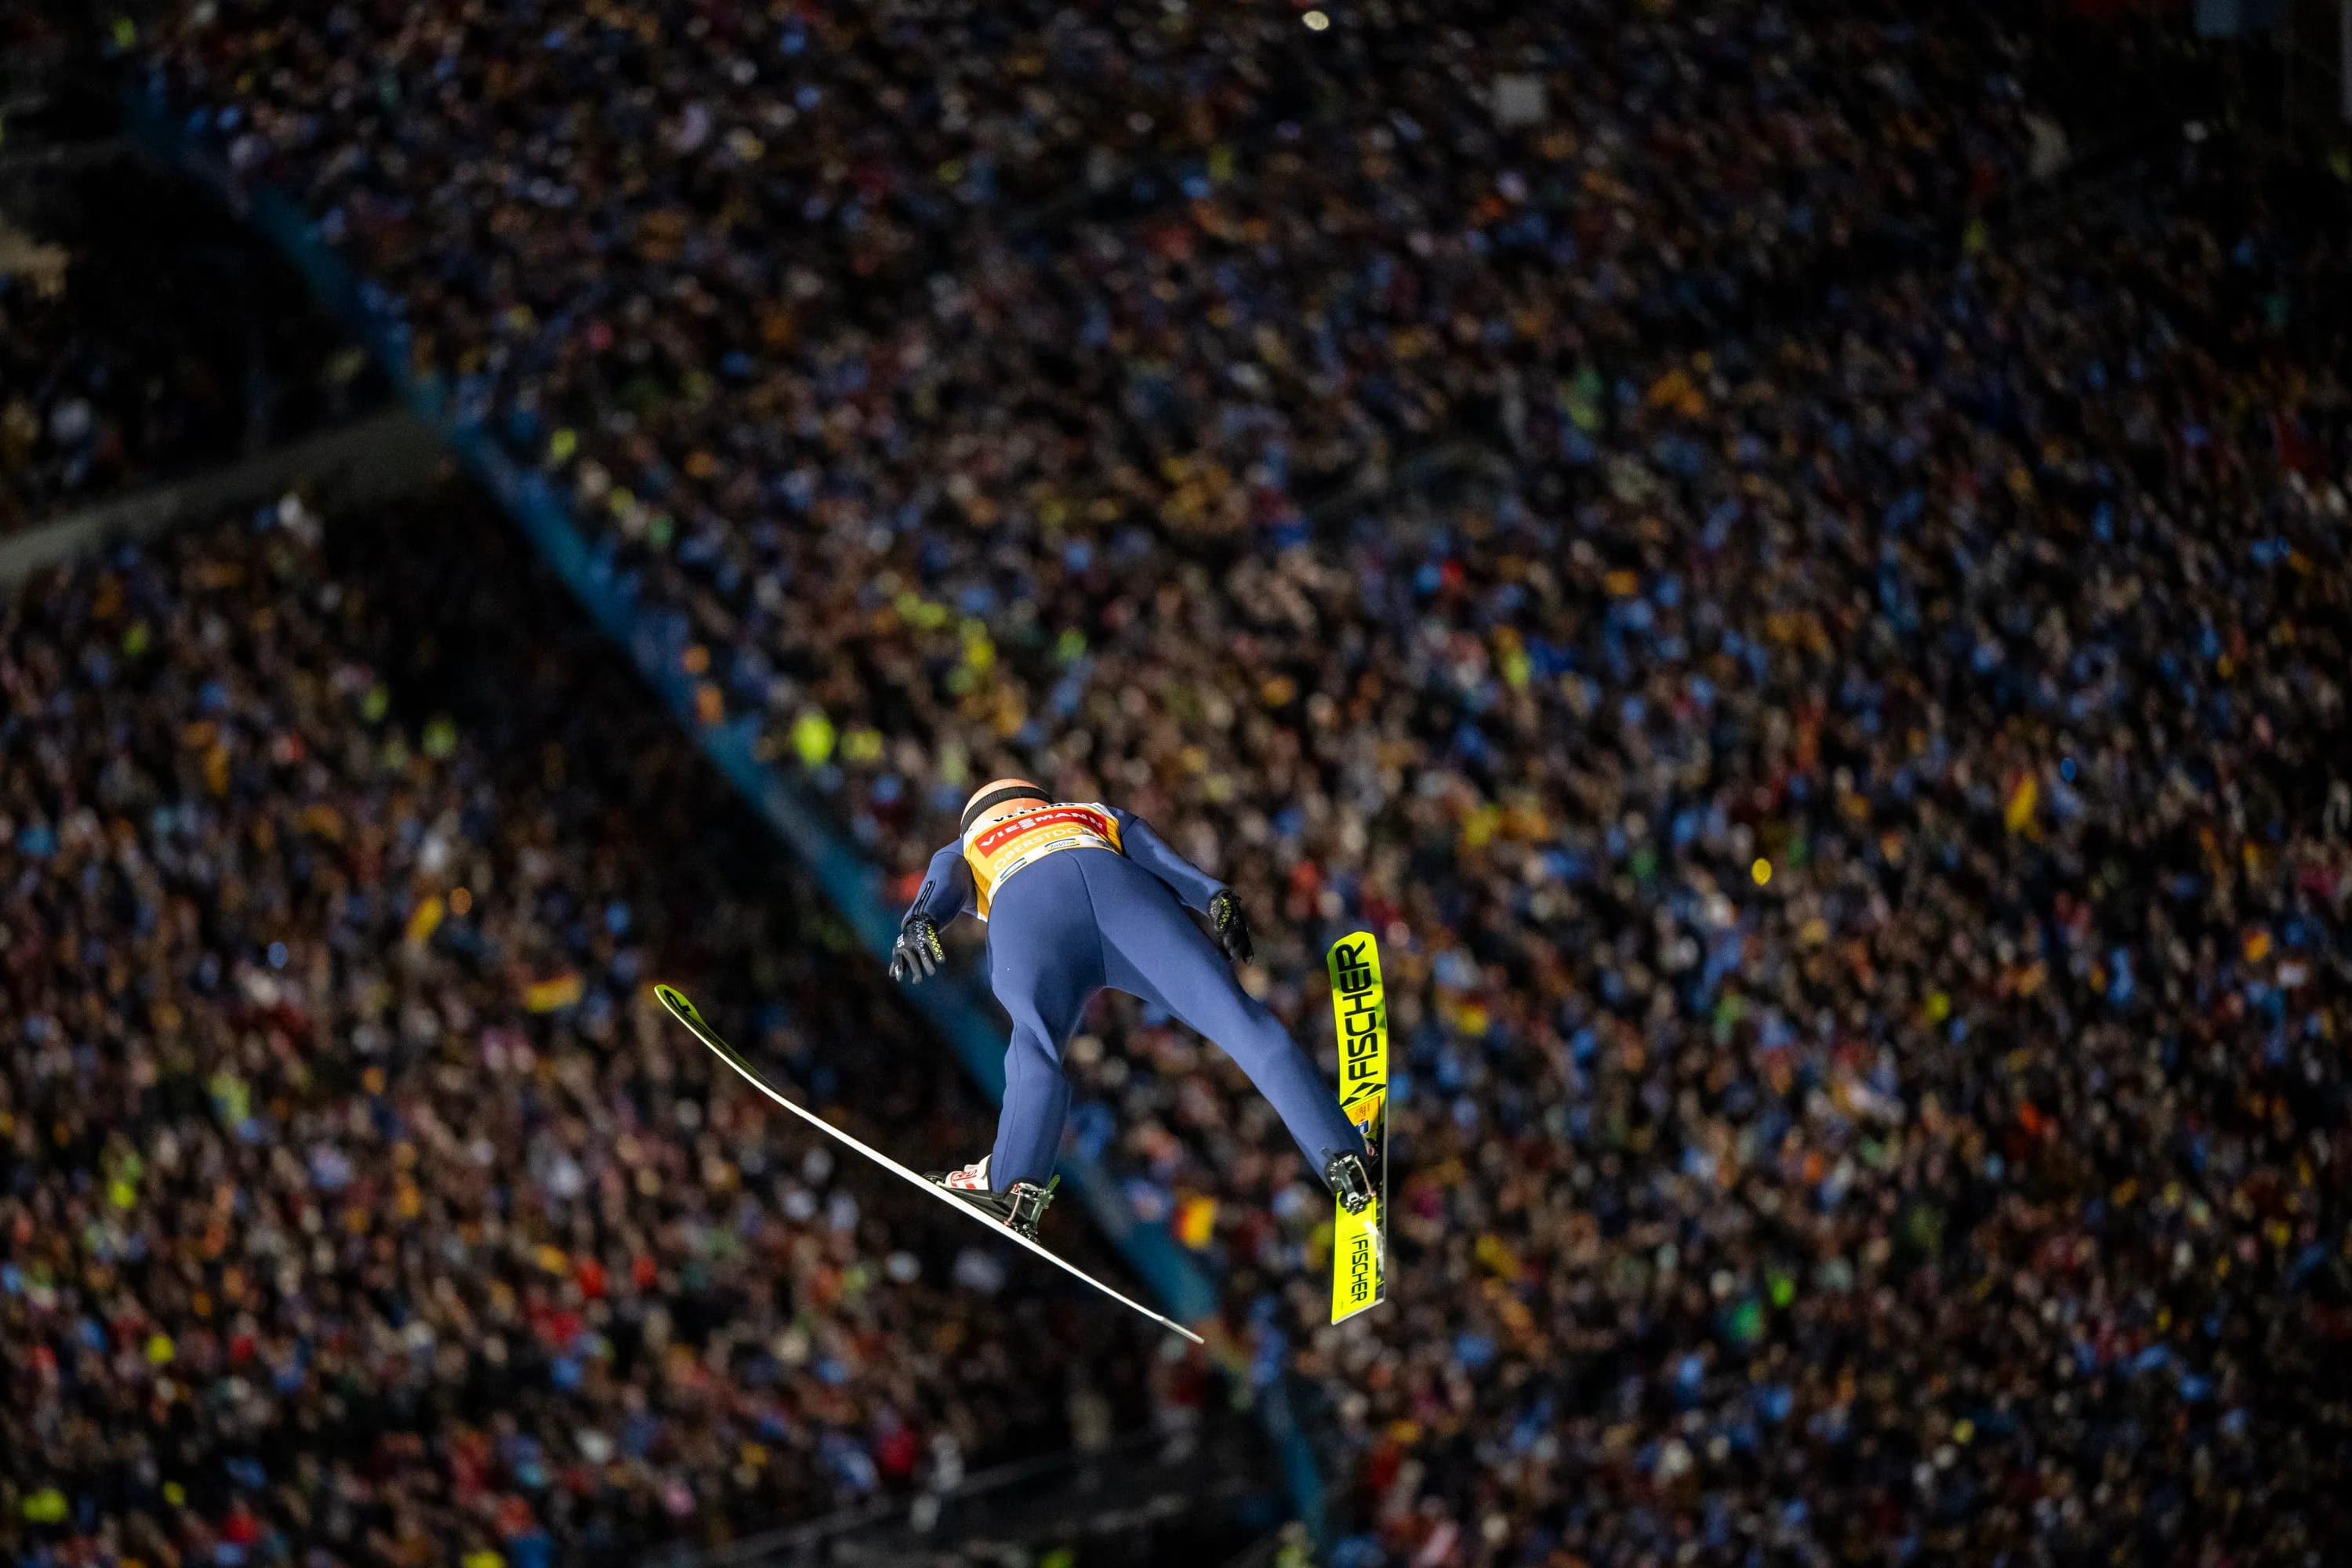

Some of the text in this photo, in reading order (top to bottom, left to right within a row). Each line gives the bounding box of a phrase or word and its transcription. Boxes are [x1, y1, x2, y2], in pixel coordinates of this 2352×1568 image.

[993, 827, 1101, 871] OBERSTDO
[1334, 940, 1378, 1081] FISCHER
[1350, 1239, 1368, 1304] FISCHER
